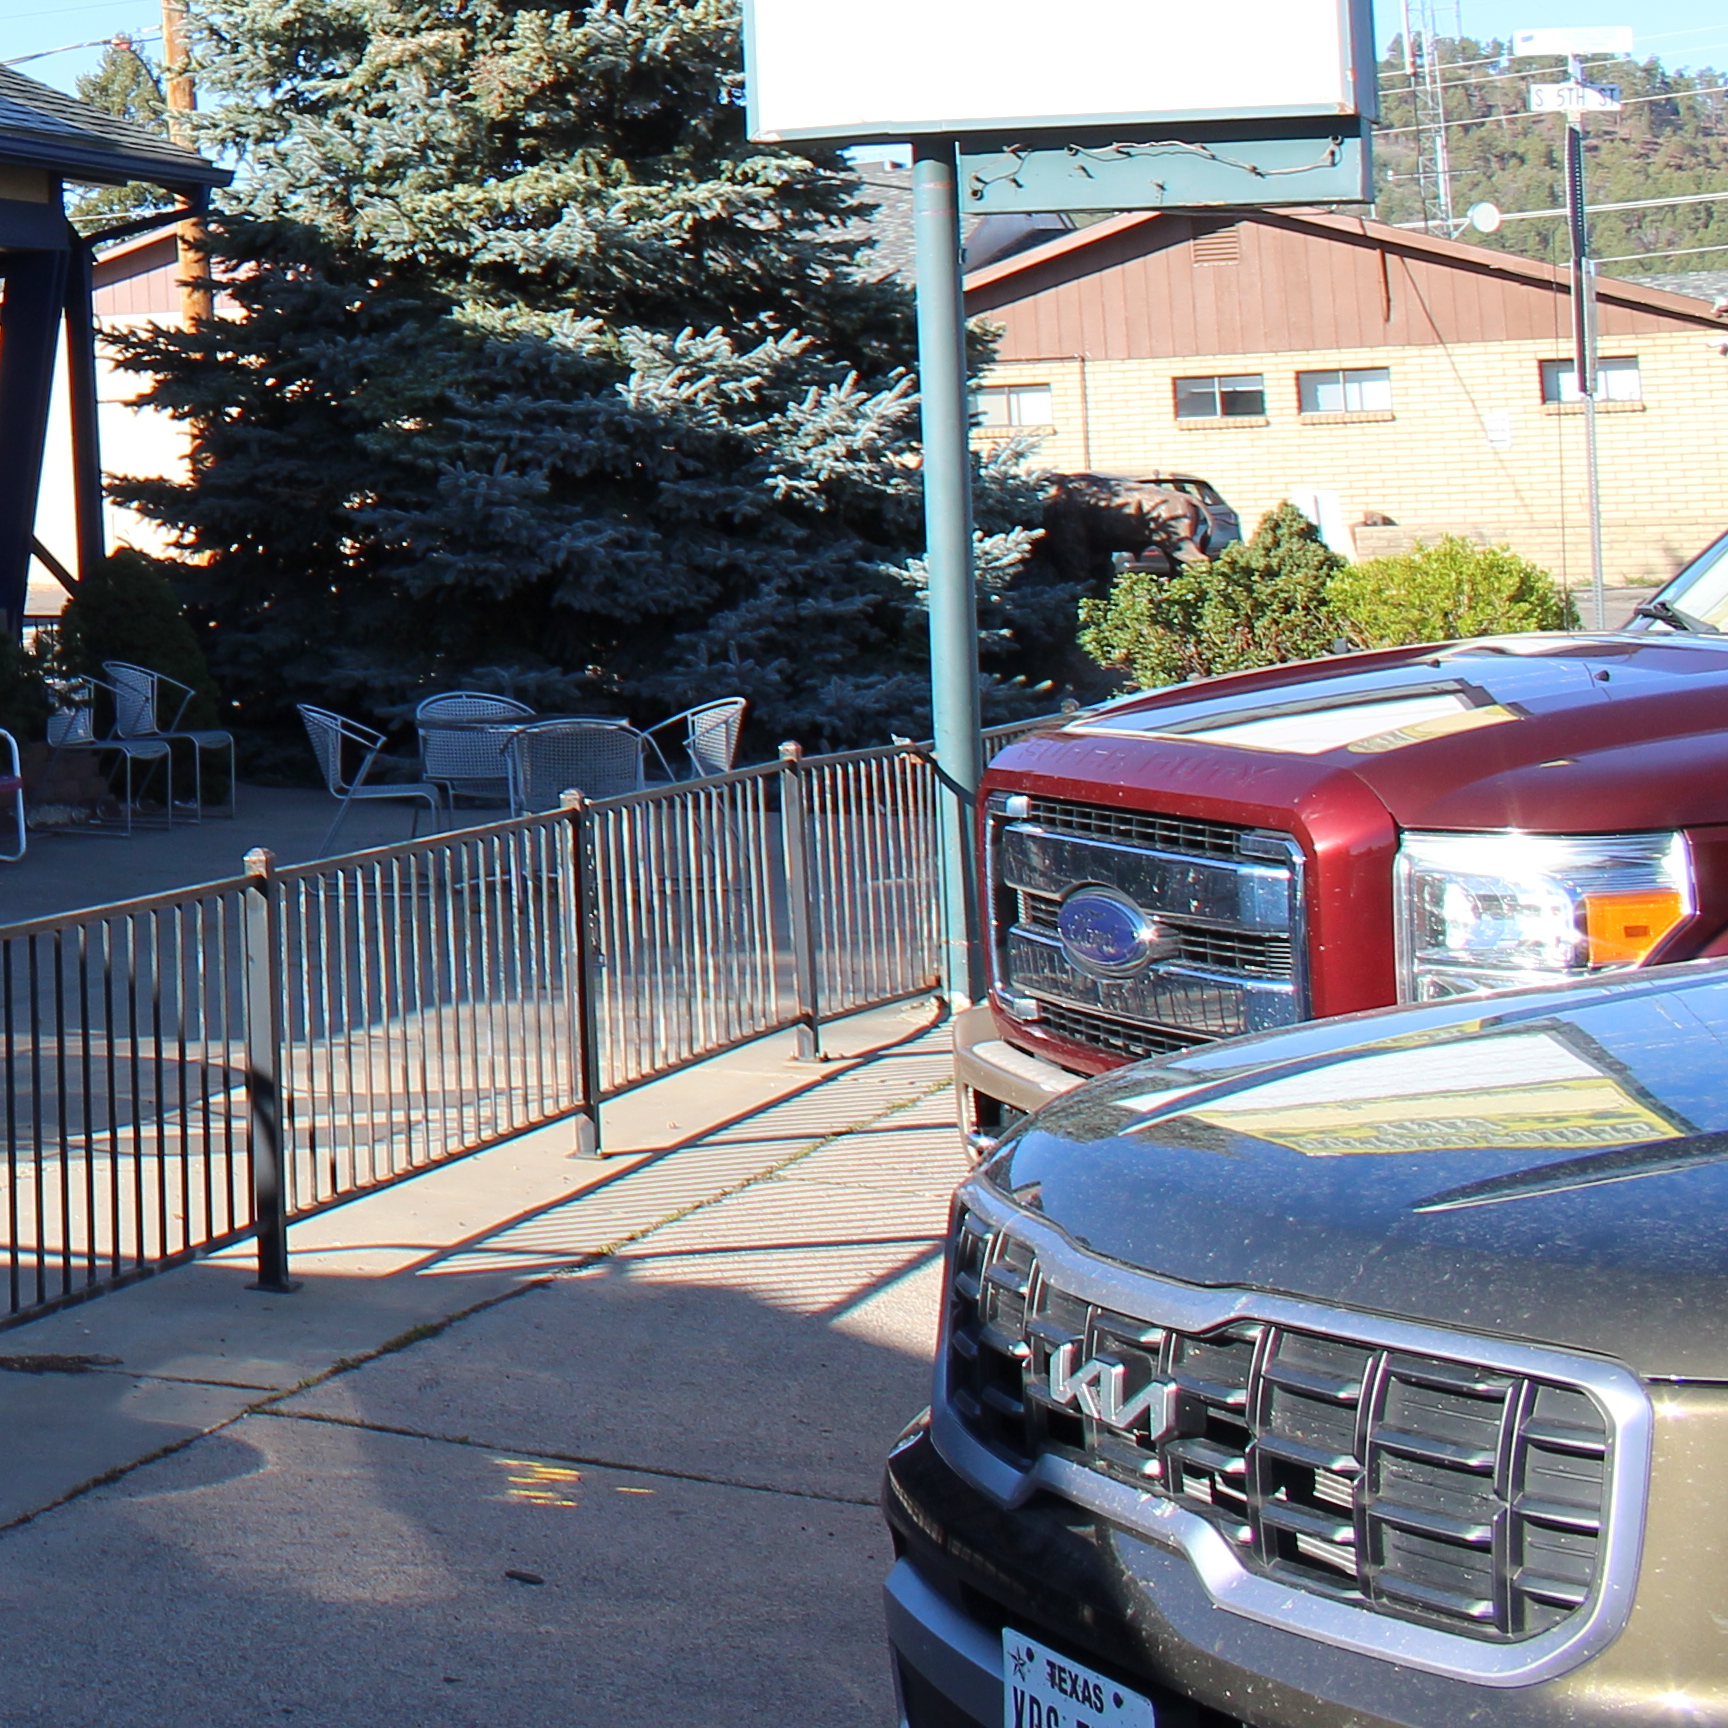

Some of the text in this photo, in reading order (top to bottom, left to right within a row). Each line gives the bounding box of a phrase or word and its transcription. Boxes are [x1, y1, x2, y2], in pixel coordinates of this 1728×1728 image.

[1534, 86, 1616, 107] S 5TH ST
[1045, 1658, 1105, 1714] TEXAS
